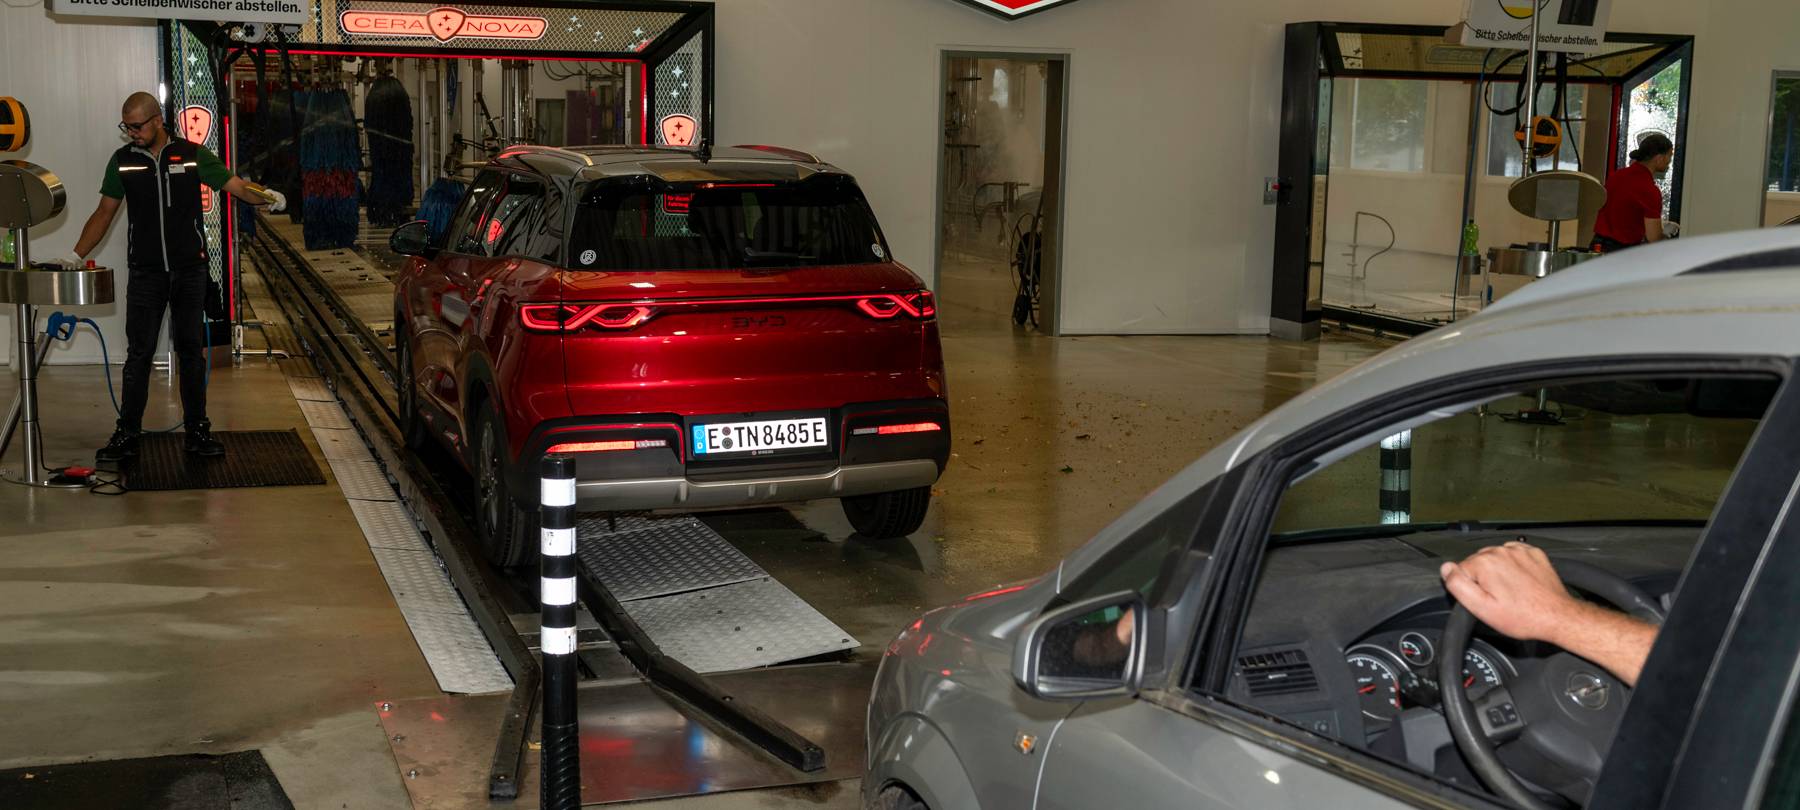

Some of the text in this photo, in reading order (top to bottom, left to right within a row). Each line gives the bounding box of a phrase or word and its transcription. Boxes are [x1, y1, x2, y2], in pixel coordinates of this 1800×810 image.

[235, 0, 302, 13] abstellen.
[354, 17, 534, 34] CERA NOVA
[1475, 29, 1599, 46] Bitte Scheibeischer abstellen.
[732, 315, 787, 328] BYD
